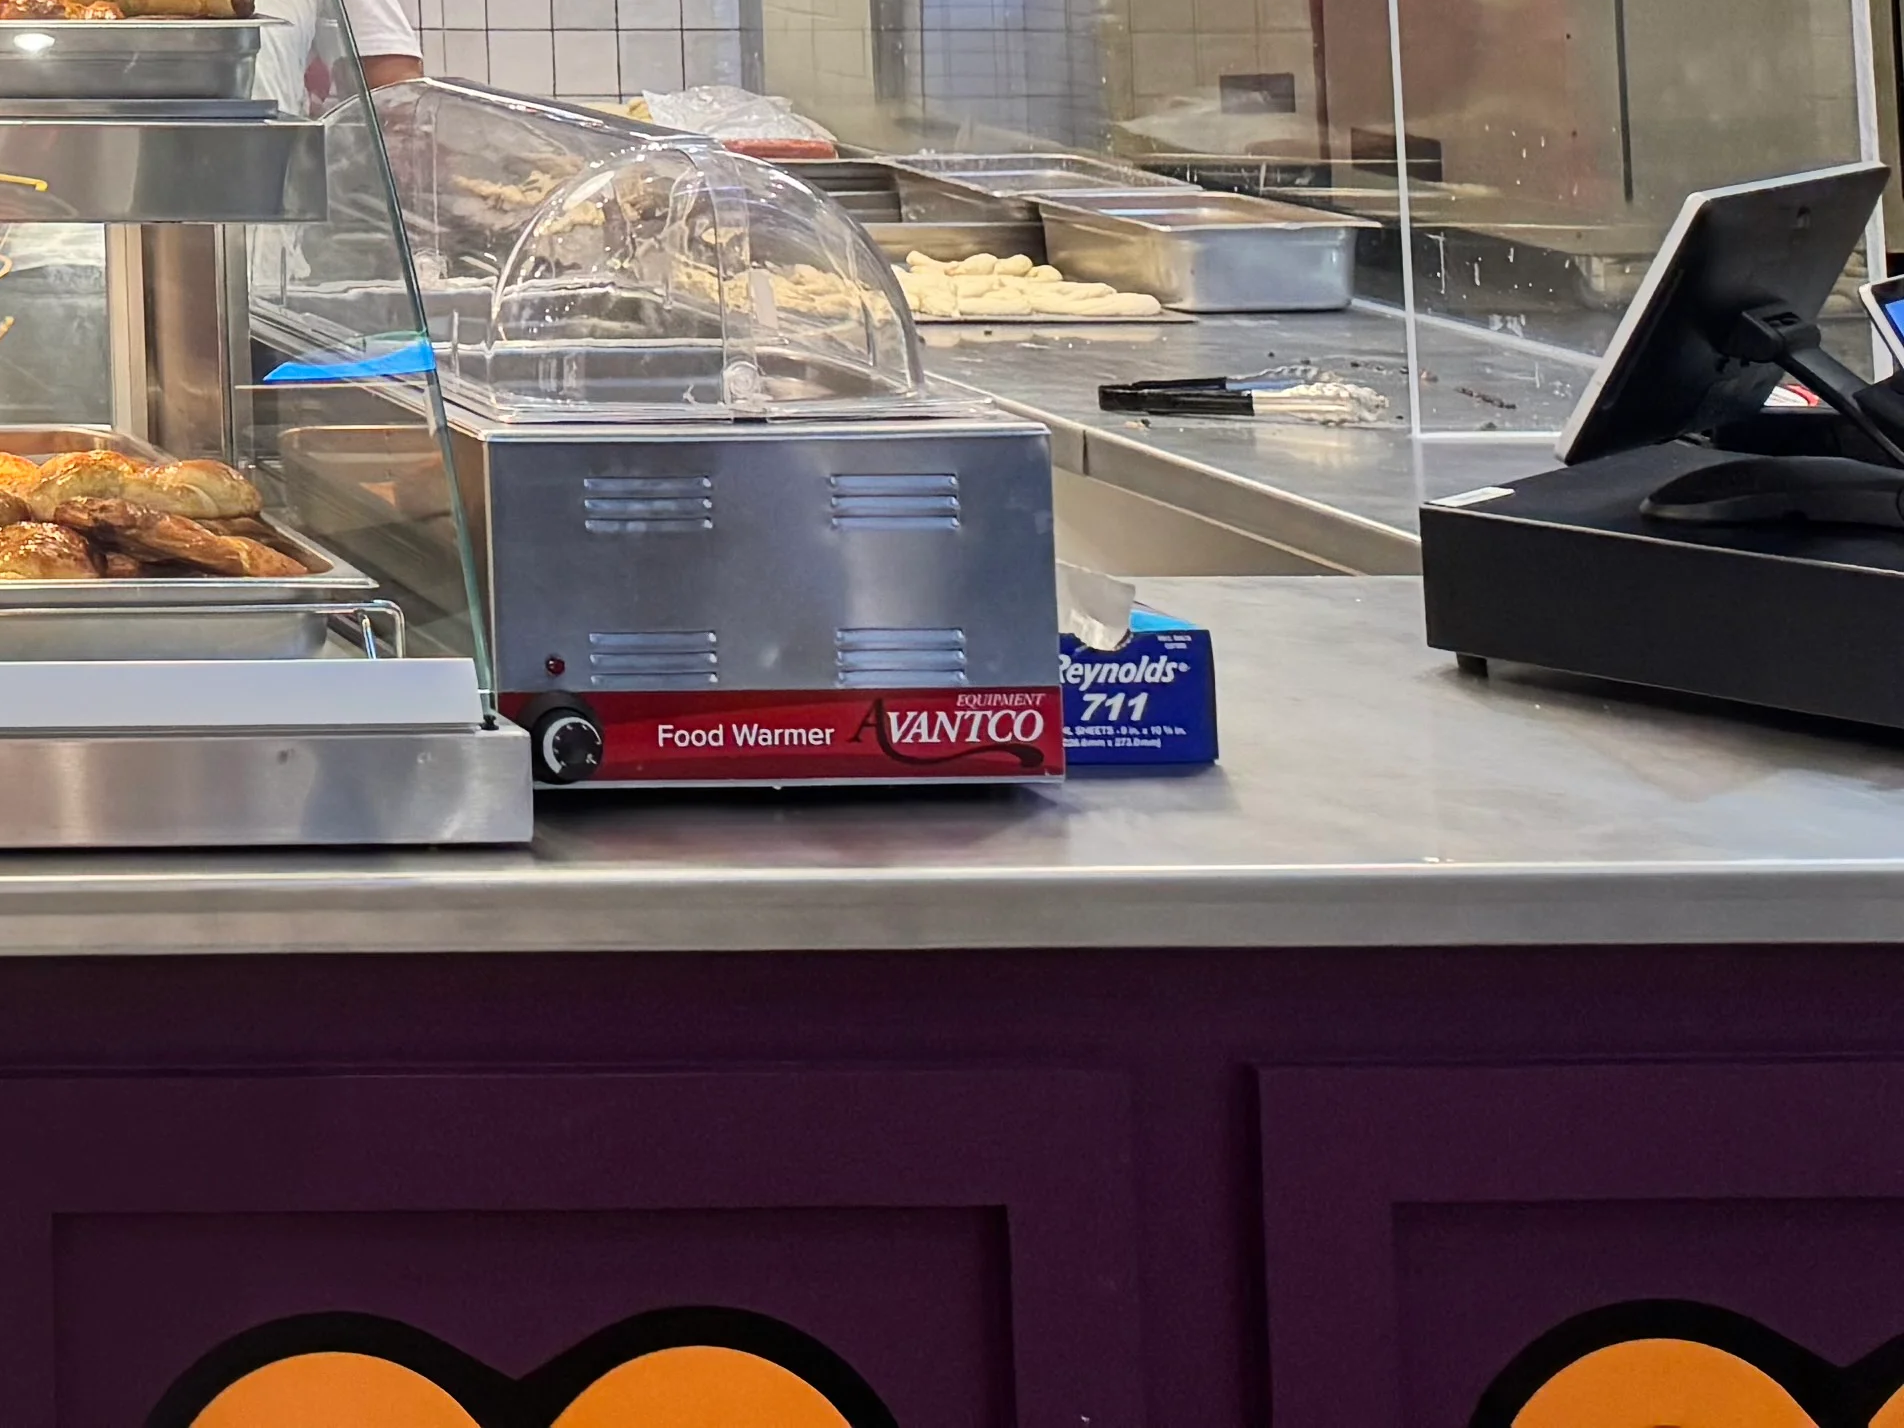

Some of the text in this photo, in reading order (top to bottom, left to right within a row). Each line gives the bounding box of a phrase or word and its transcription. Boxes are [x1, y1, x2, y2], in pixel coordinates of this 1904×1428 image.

[956, 693, 1045, 708] EQUIPMENT
[1080, 692, 1149, 722] 711
[658, 722, 836, 747] Food Warmer
